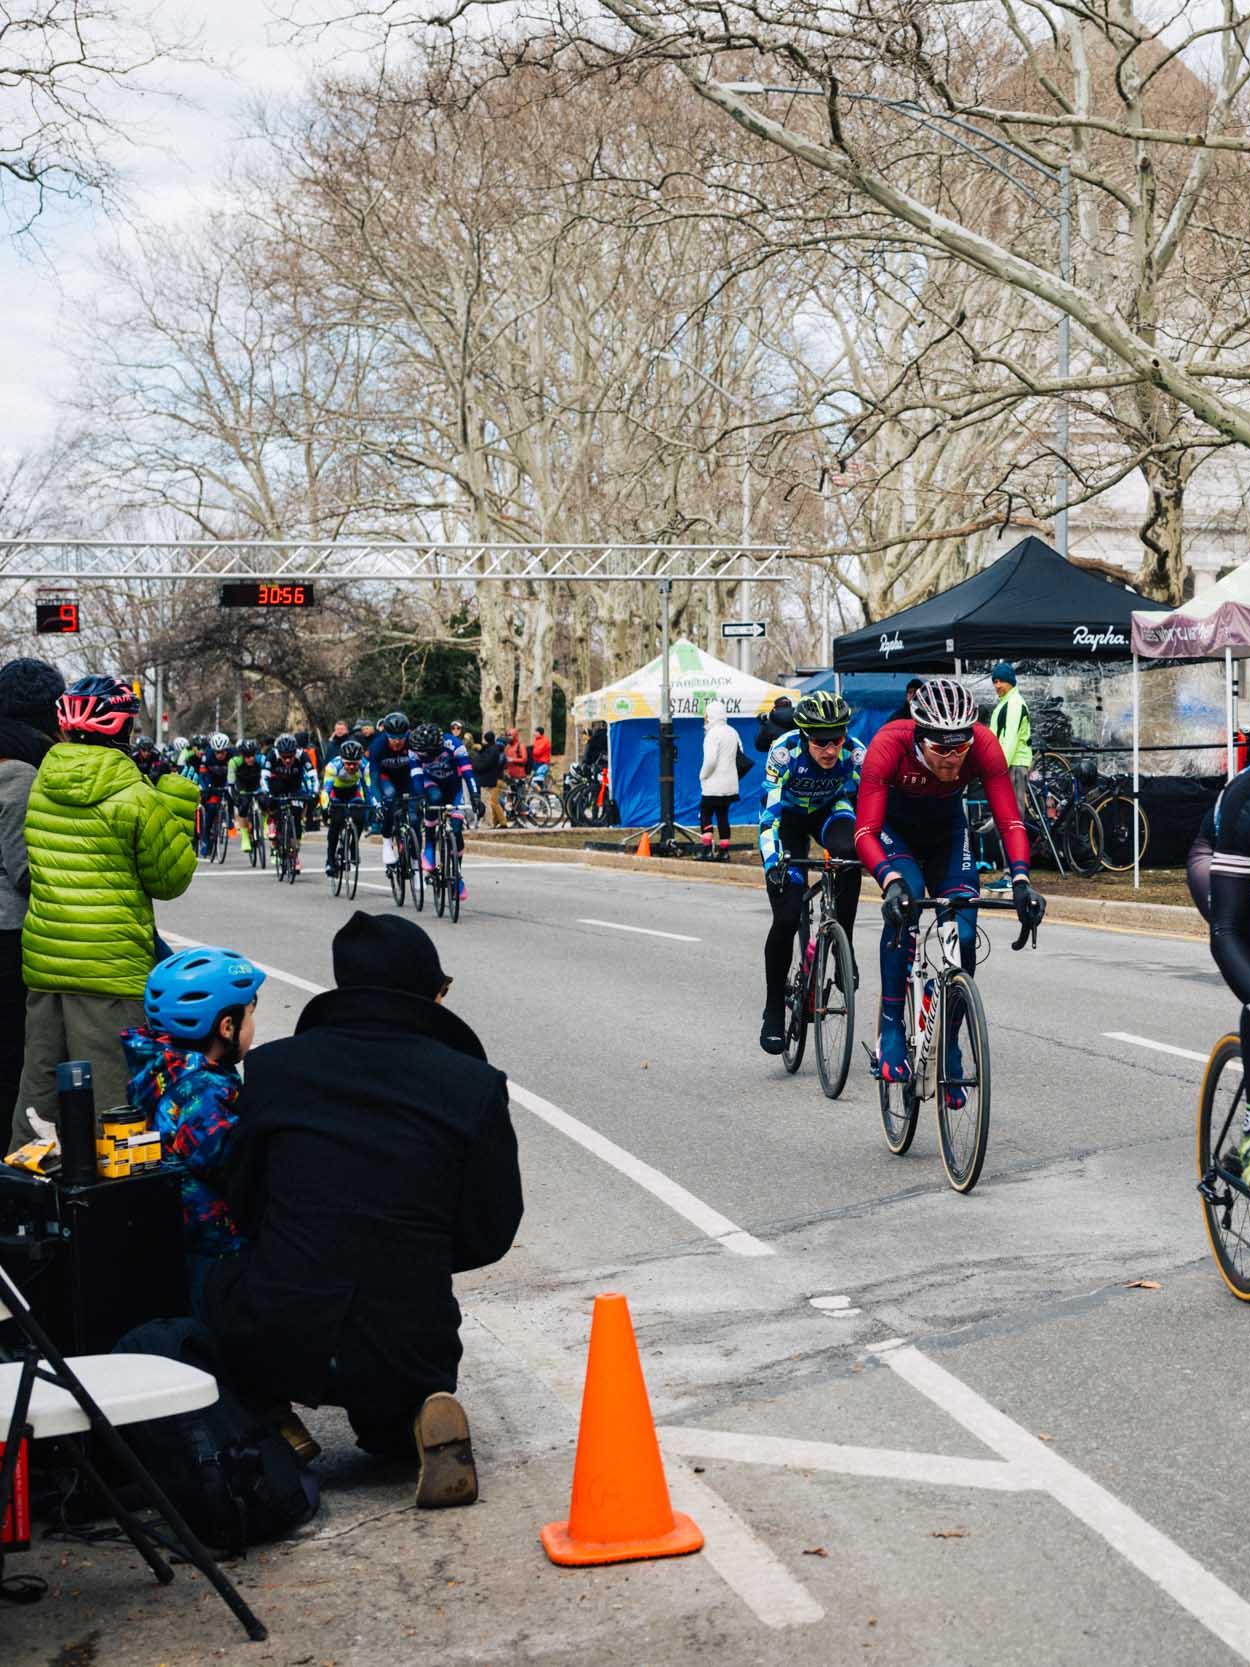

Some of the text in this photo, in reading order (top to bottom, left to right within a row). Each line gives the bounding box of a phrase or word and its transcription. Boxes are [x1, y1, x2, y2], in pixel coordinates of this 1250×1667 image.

[258, 587, 305, 605] 30:56
[59, 604, 78, 633] 9
[670, 698, 699, 714] STAR
